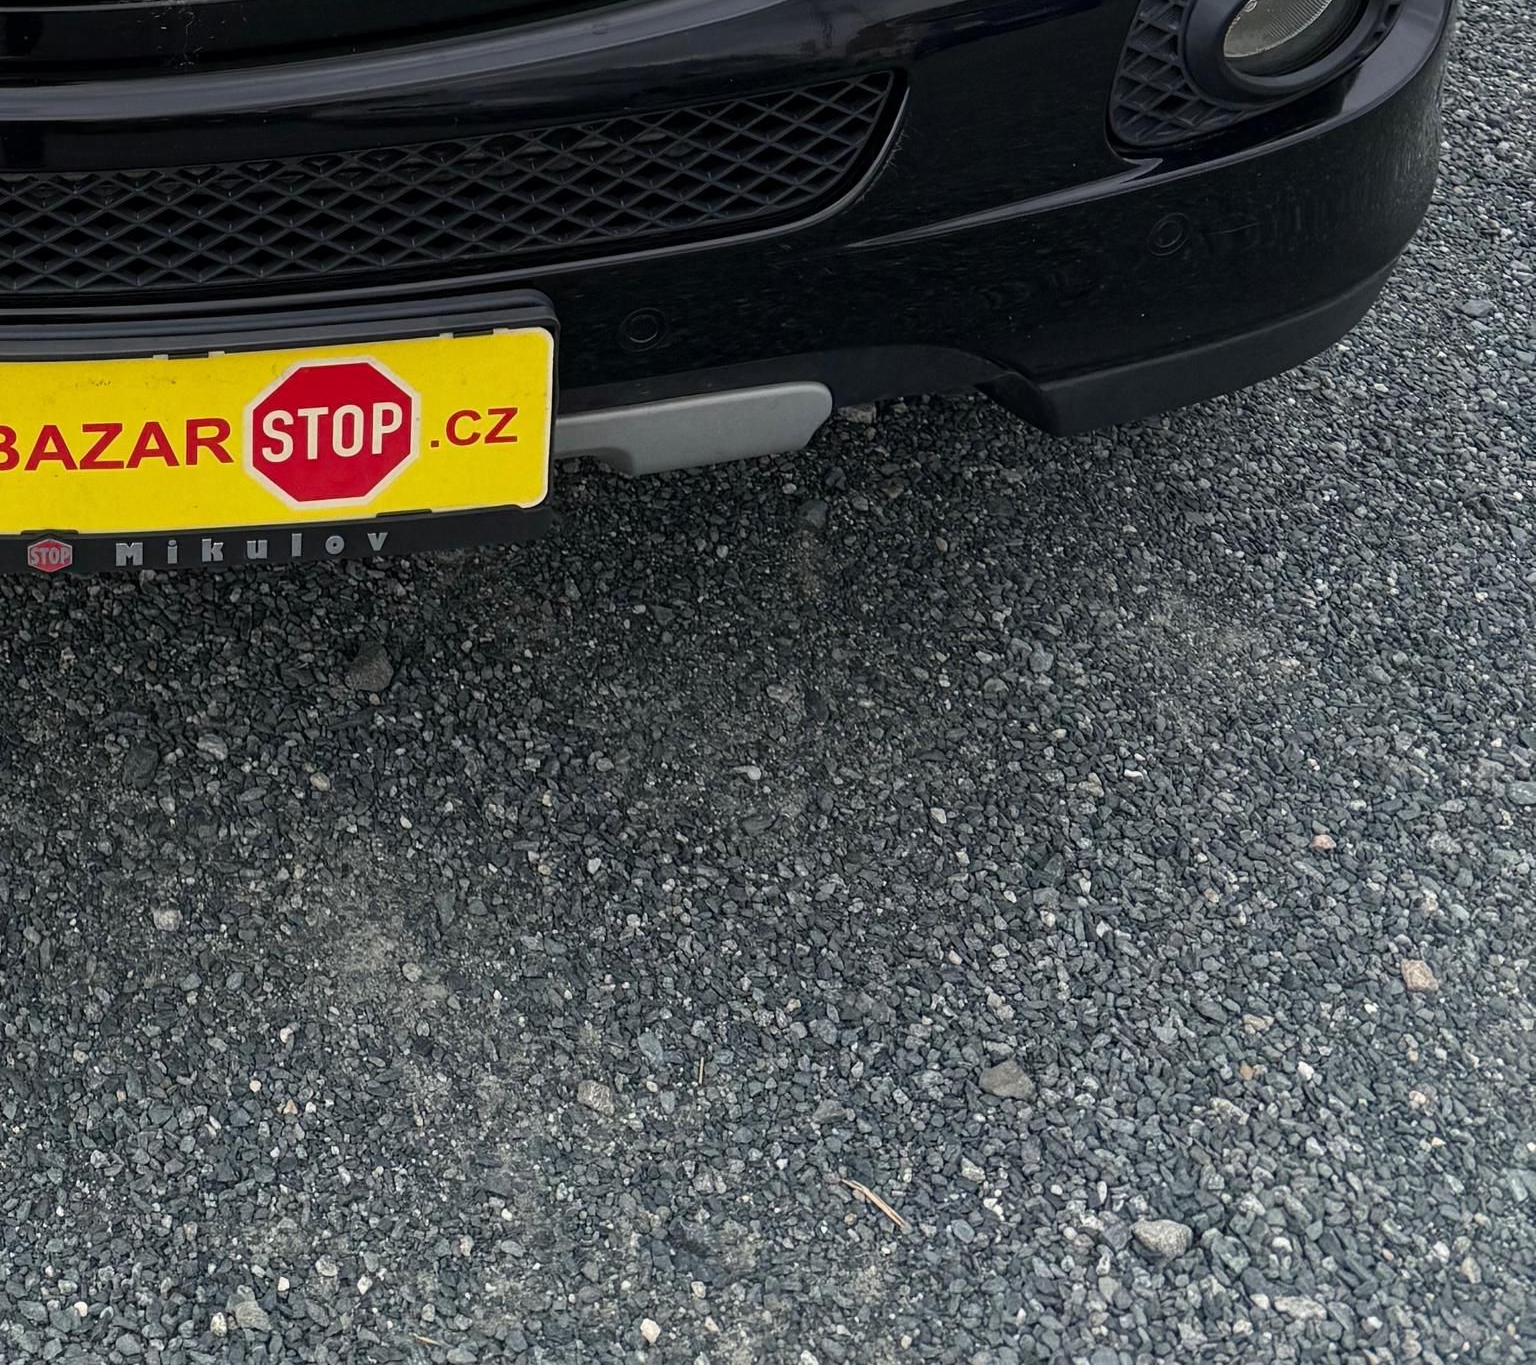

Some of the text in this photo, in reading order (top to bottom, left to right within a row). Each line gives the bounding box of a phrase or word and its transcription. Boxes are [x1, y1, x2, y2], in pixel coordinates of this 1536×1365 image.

[261, 401, 404, 464] STOP
[28, 544, 73, 568] STOP
[115, 531, 389, 568] Mikulov
